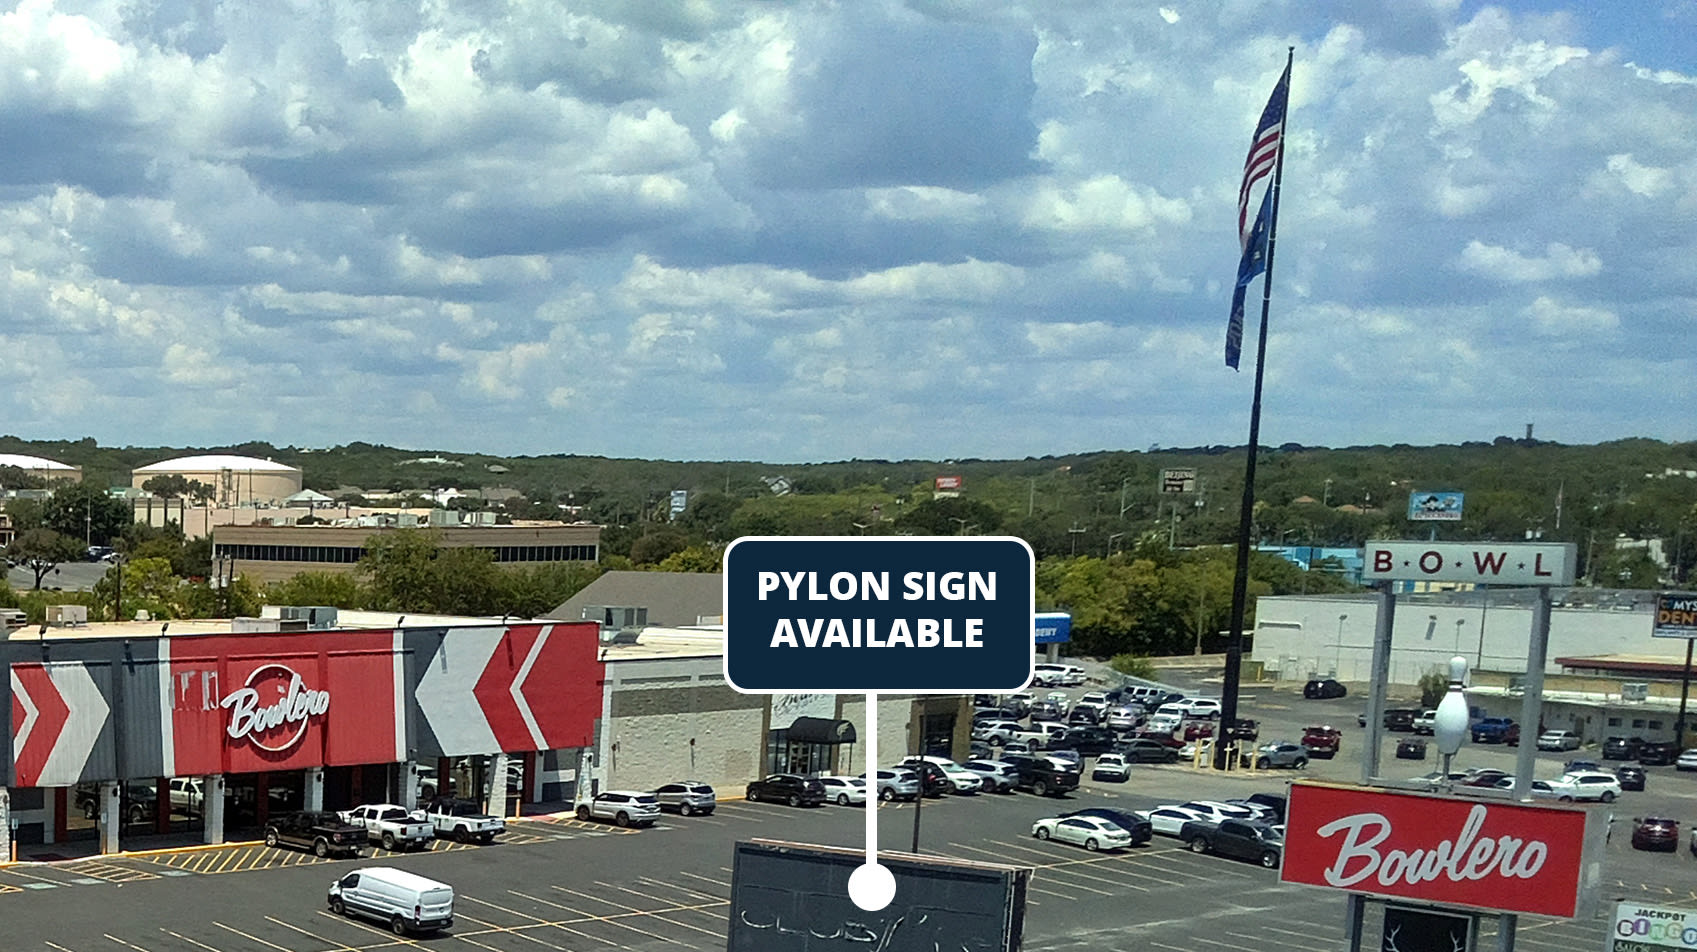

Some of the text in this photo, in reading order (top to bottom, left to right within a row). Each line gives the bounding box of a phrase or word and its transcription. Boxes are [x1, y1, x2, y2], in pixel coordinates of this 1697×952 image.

[220, 673, 330, 738] Bowlero
[1317, 804, 1547, 888] Bowlero
[1617, 919, 1697, 945] BINGO
[1634, 909, 1686, 922] JACKPOT
